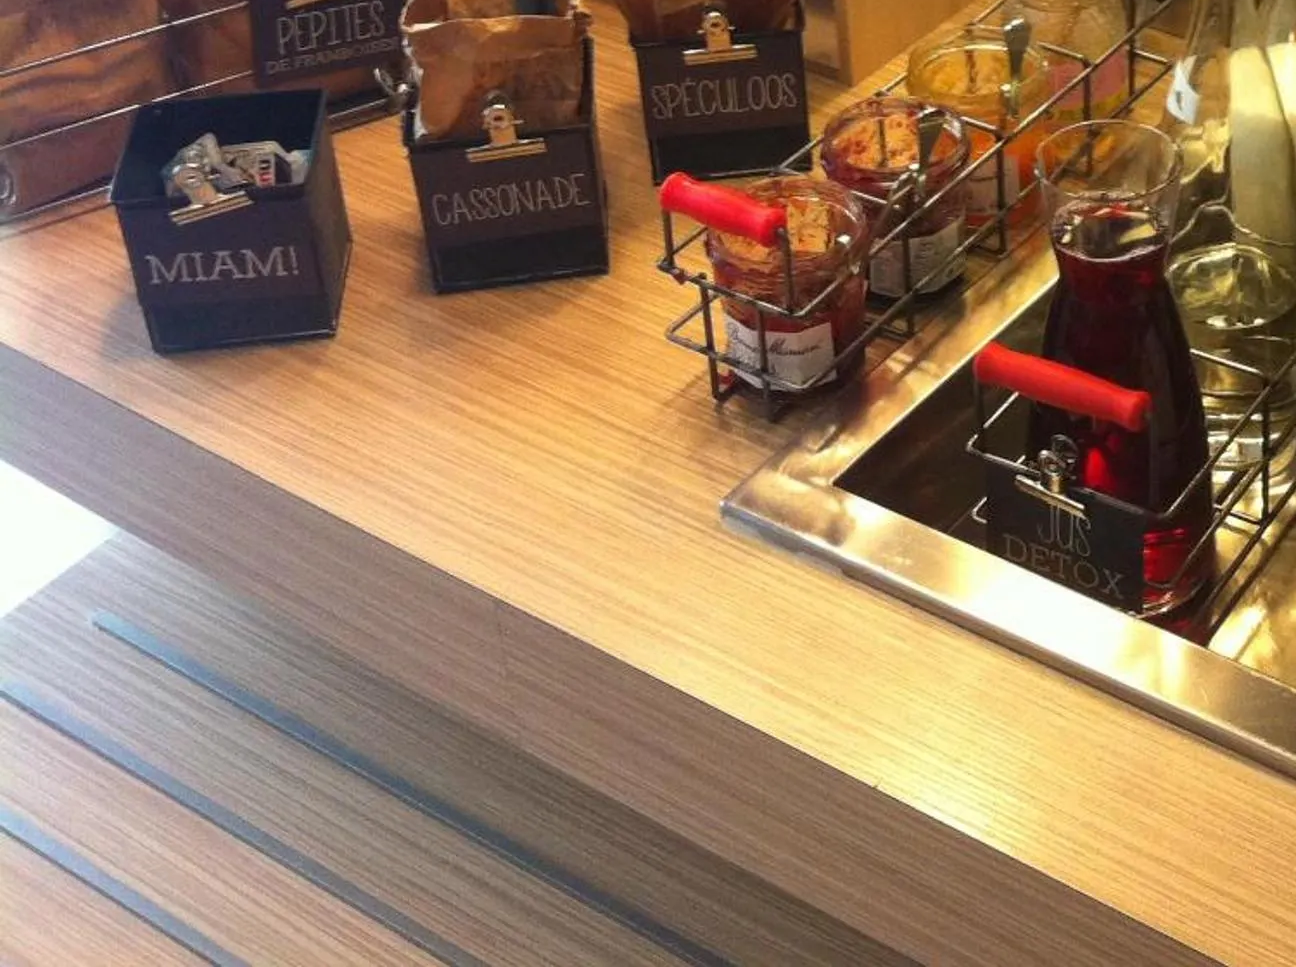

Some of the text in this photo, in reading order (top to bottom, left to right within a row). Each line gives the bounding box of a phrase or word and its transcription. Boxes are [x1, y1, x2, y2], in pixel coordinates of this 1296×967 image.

[266, 57, 290, 74] DE
[652, 73, 797, 120] SPÉCULOOS
[432, 173, 592, 225] CASSONADE
[144, 245, 299, 284] MIAM!
[1037, 504, 1091, 557] JUS
[1002, 532, 1124, 599] DETOX
